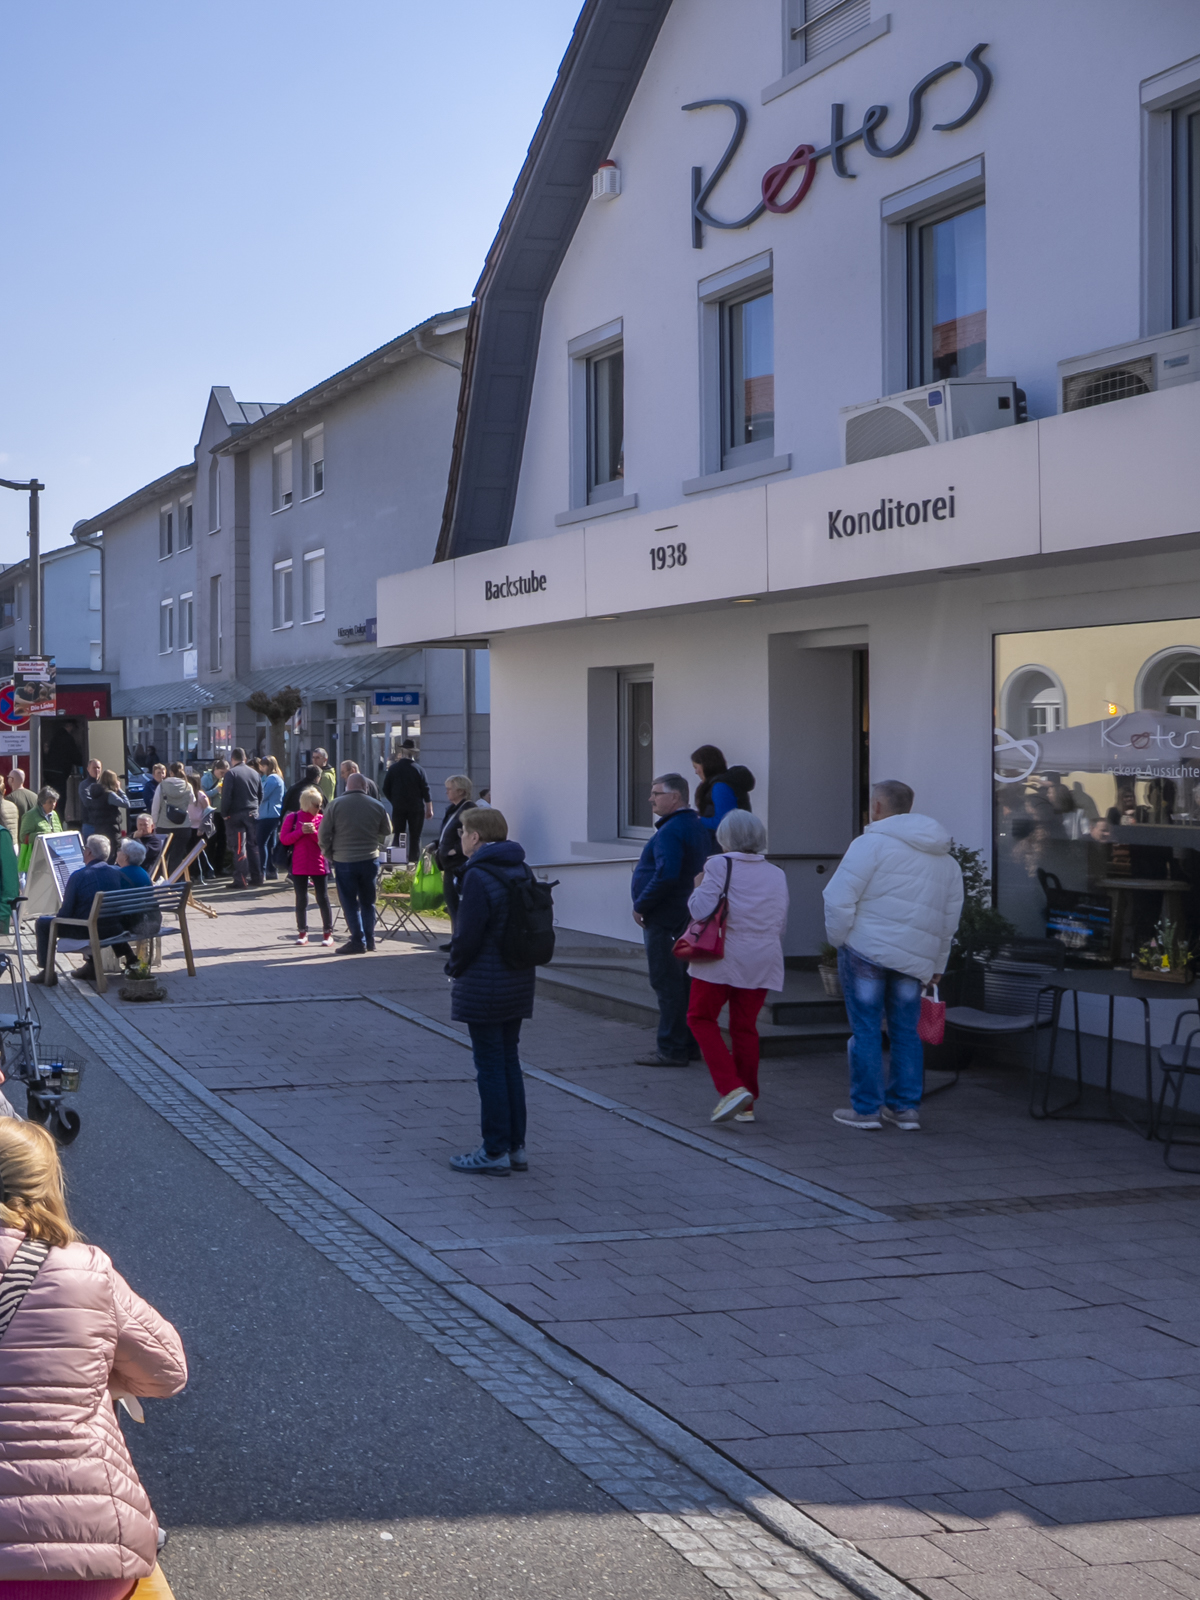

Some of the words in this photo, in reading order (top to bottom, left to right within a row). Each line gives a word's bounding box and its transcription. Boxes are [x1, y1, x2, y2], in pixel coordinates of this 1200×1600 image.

[828, 485, 956, 540] Konditorei
[649, 542, 688, 571] 1938
[484, 570, 547, 601] Backstube
[40, 702, 55, 710] Linke
[1101, 700, 1200, 751] Roter
[1101, 763, 1142, 777] Leckere
[1144, 763, 1200, 778] Aussichte
